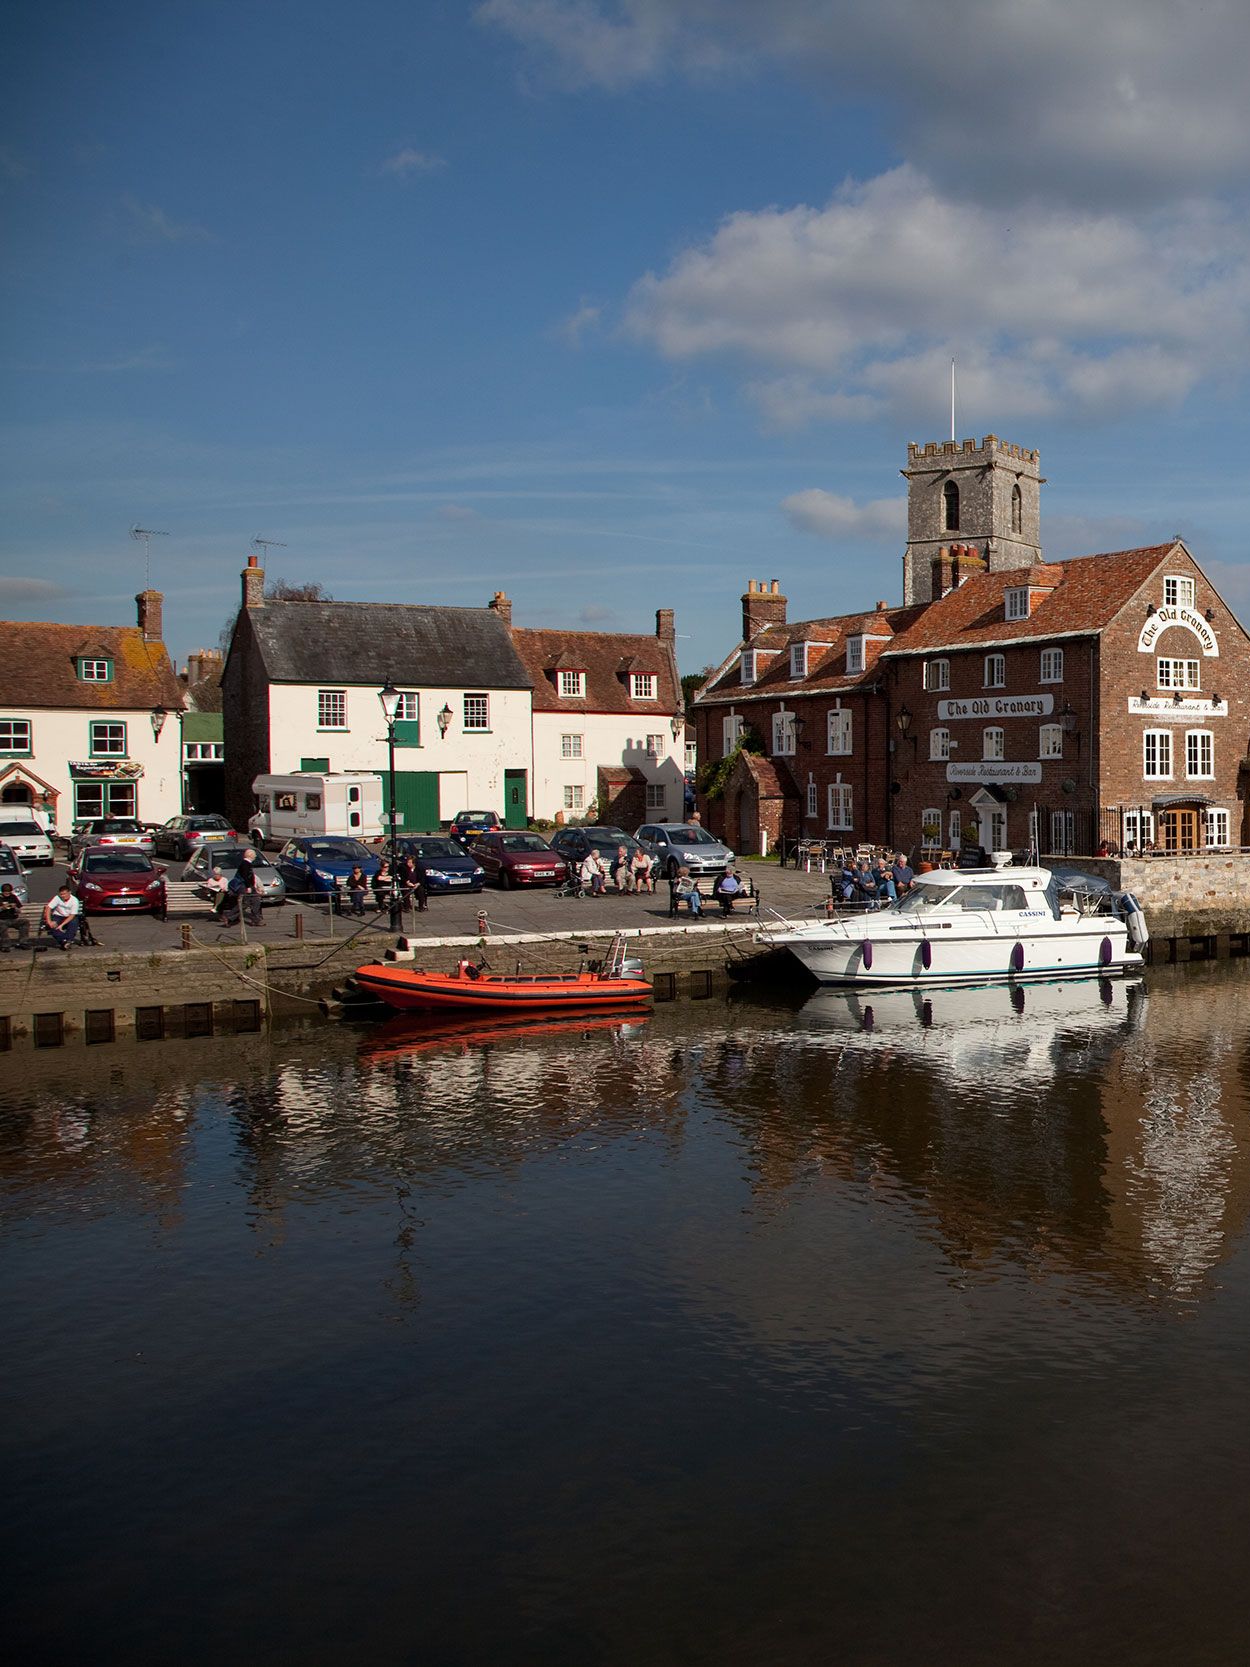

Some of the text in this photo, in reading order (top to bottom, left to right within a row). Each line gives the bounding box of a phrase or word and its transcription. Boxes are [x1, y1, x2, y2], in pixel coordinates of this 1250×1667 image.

[1141, 608, 1214, 650] The Old Granary
[947, 699, 1044, 717] The Old Granary
[950, 764, 976, 777] Riverside
[978, 764, 1014, 777] Restaurant
[1022, 764, 1037, 777] Bar
